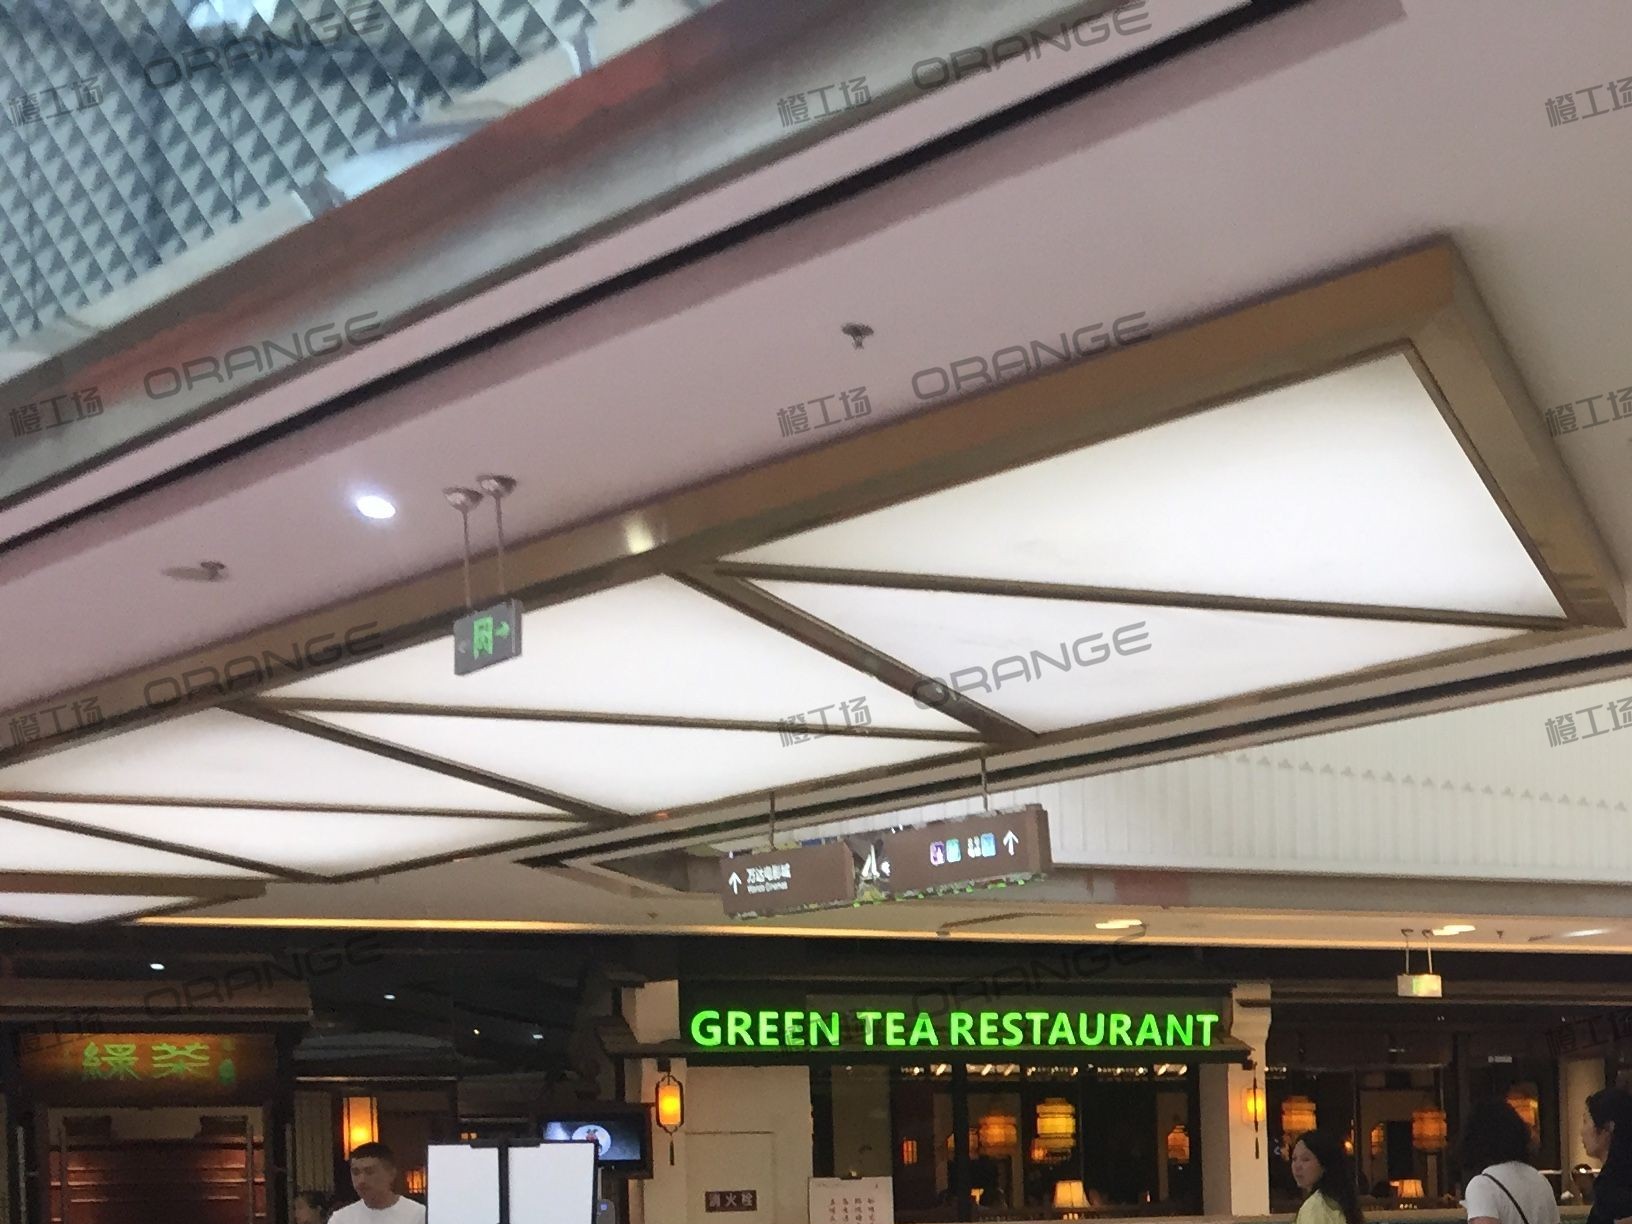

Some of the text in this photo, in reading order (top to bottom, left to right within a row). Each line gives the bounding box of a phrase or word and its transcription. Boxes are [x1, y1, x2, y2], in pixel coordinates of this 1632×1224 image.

[691, 1010, 1219, 1048] GREEN TEA RESTAURANT
